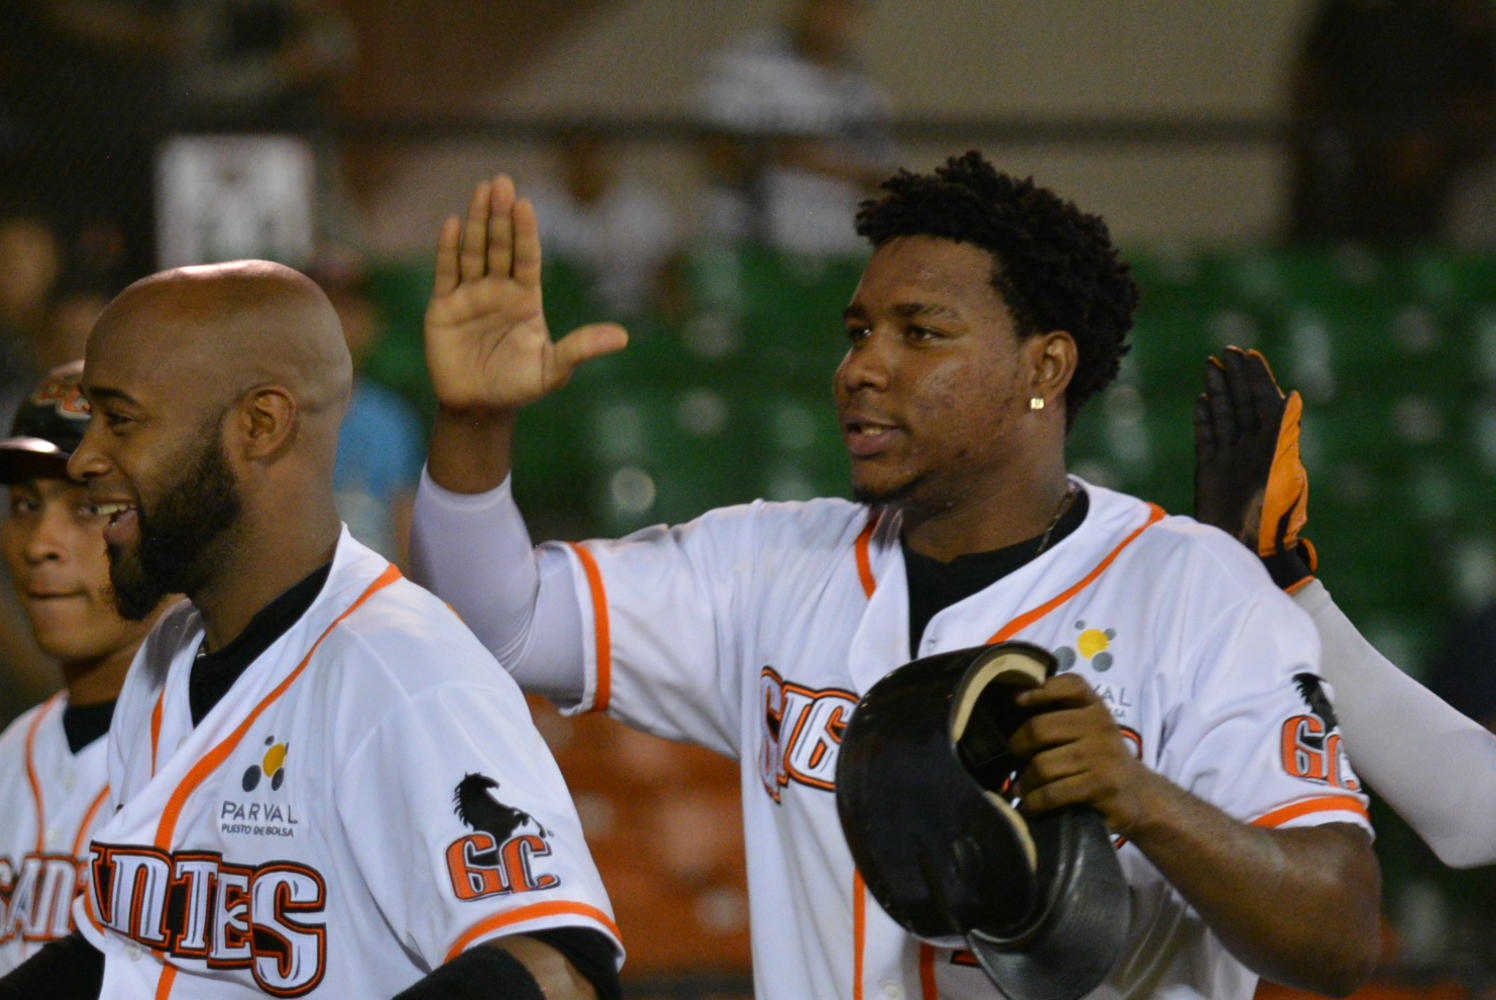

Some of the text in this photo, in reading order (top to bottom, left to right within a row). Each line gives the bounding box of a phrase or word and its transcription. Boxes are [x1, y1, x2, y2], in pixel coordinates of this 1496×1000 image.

[760, 666, 861, 805] GIG
[221, 800, 299, 825] PARVAL
[221, 823, 294, 838] PUESTO DE BOLSA
[446, 830, 561, 902] GC
[90, 840, 328, 1000] NTES
